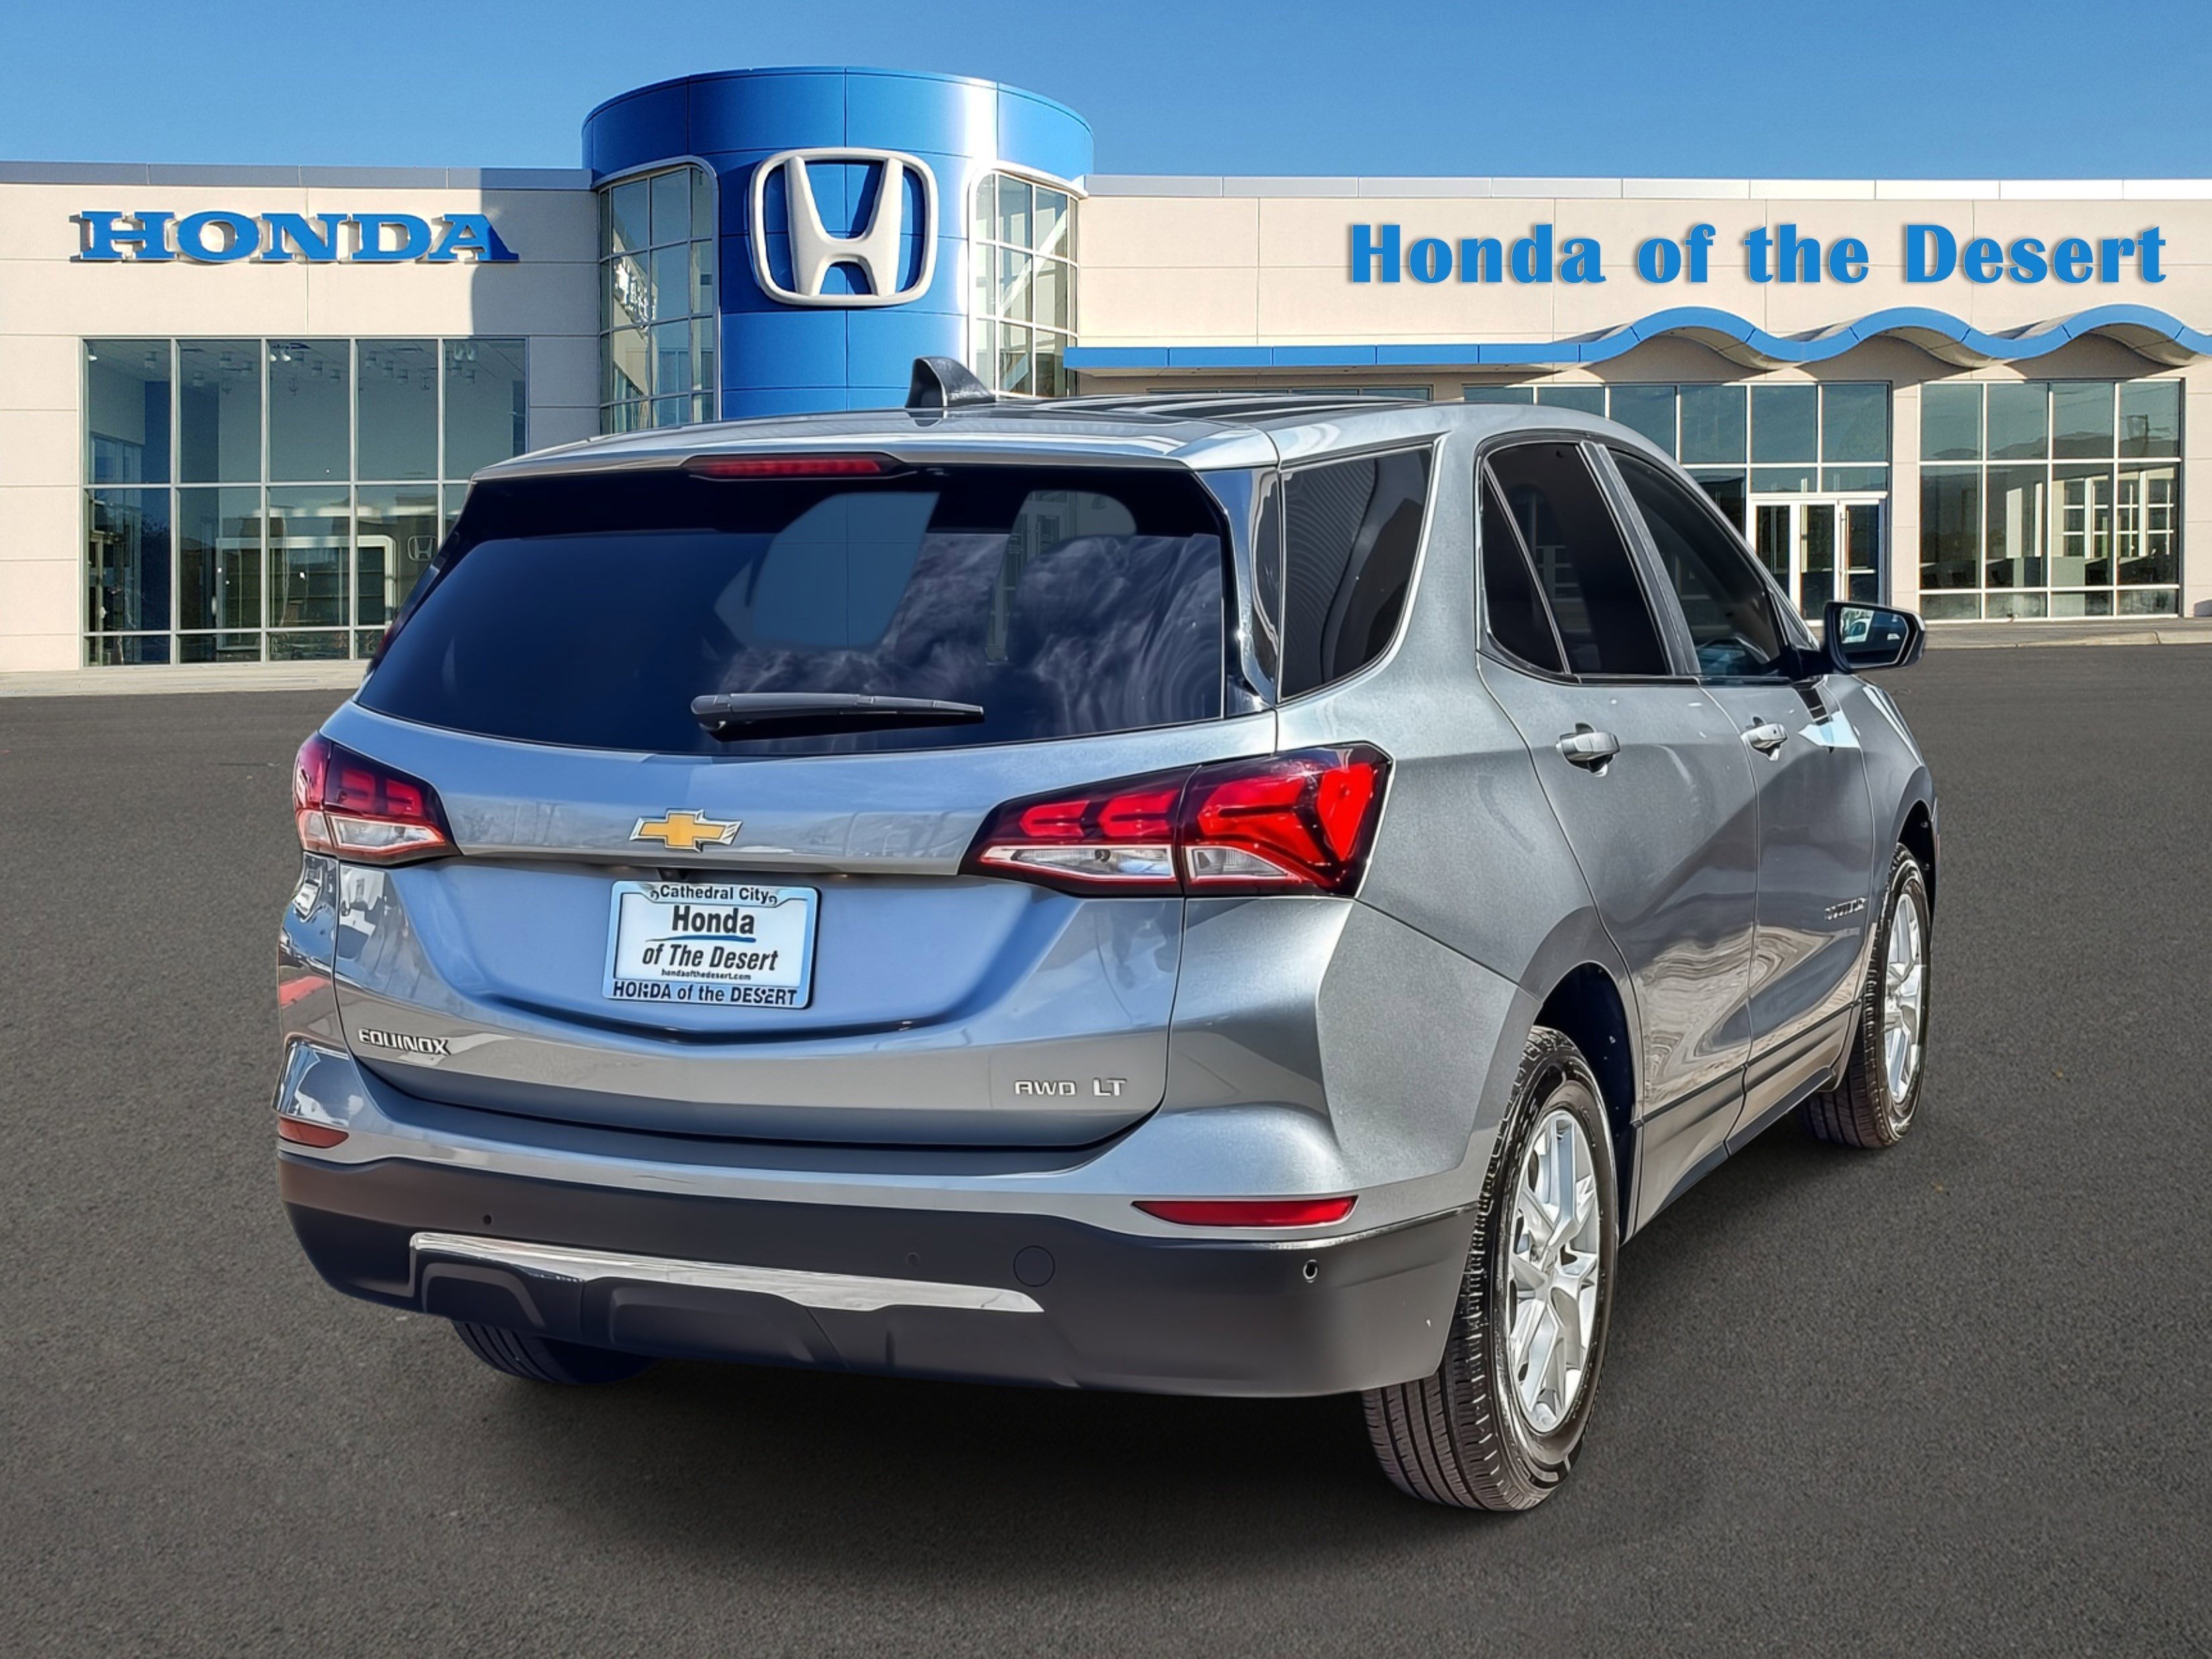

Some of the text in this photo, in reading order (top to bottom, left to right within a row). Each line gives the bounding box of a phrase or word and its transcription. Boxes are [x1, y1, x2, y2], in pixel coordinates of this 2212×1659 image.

[79, 209, 520, 263] HONDA
[1351, 223, 2167, 284] Honda of the Desert
[659, 884, 769, 903] Cathedral City
[672, 905, 755, 934] Honda
[642, 943, 778, 971] of The Desert
[661, 968, 751, 981] hondaofthedesert.com
[677, 985, 694, 1000] of
[698, 986, 725, 1002] the
[730, 987, 798, 1005] DESERT
[358, 1028, 450, 1056] EQUINOX
[1014, 1077, 1127, 1097] AWD LT
